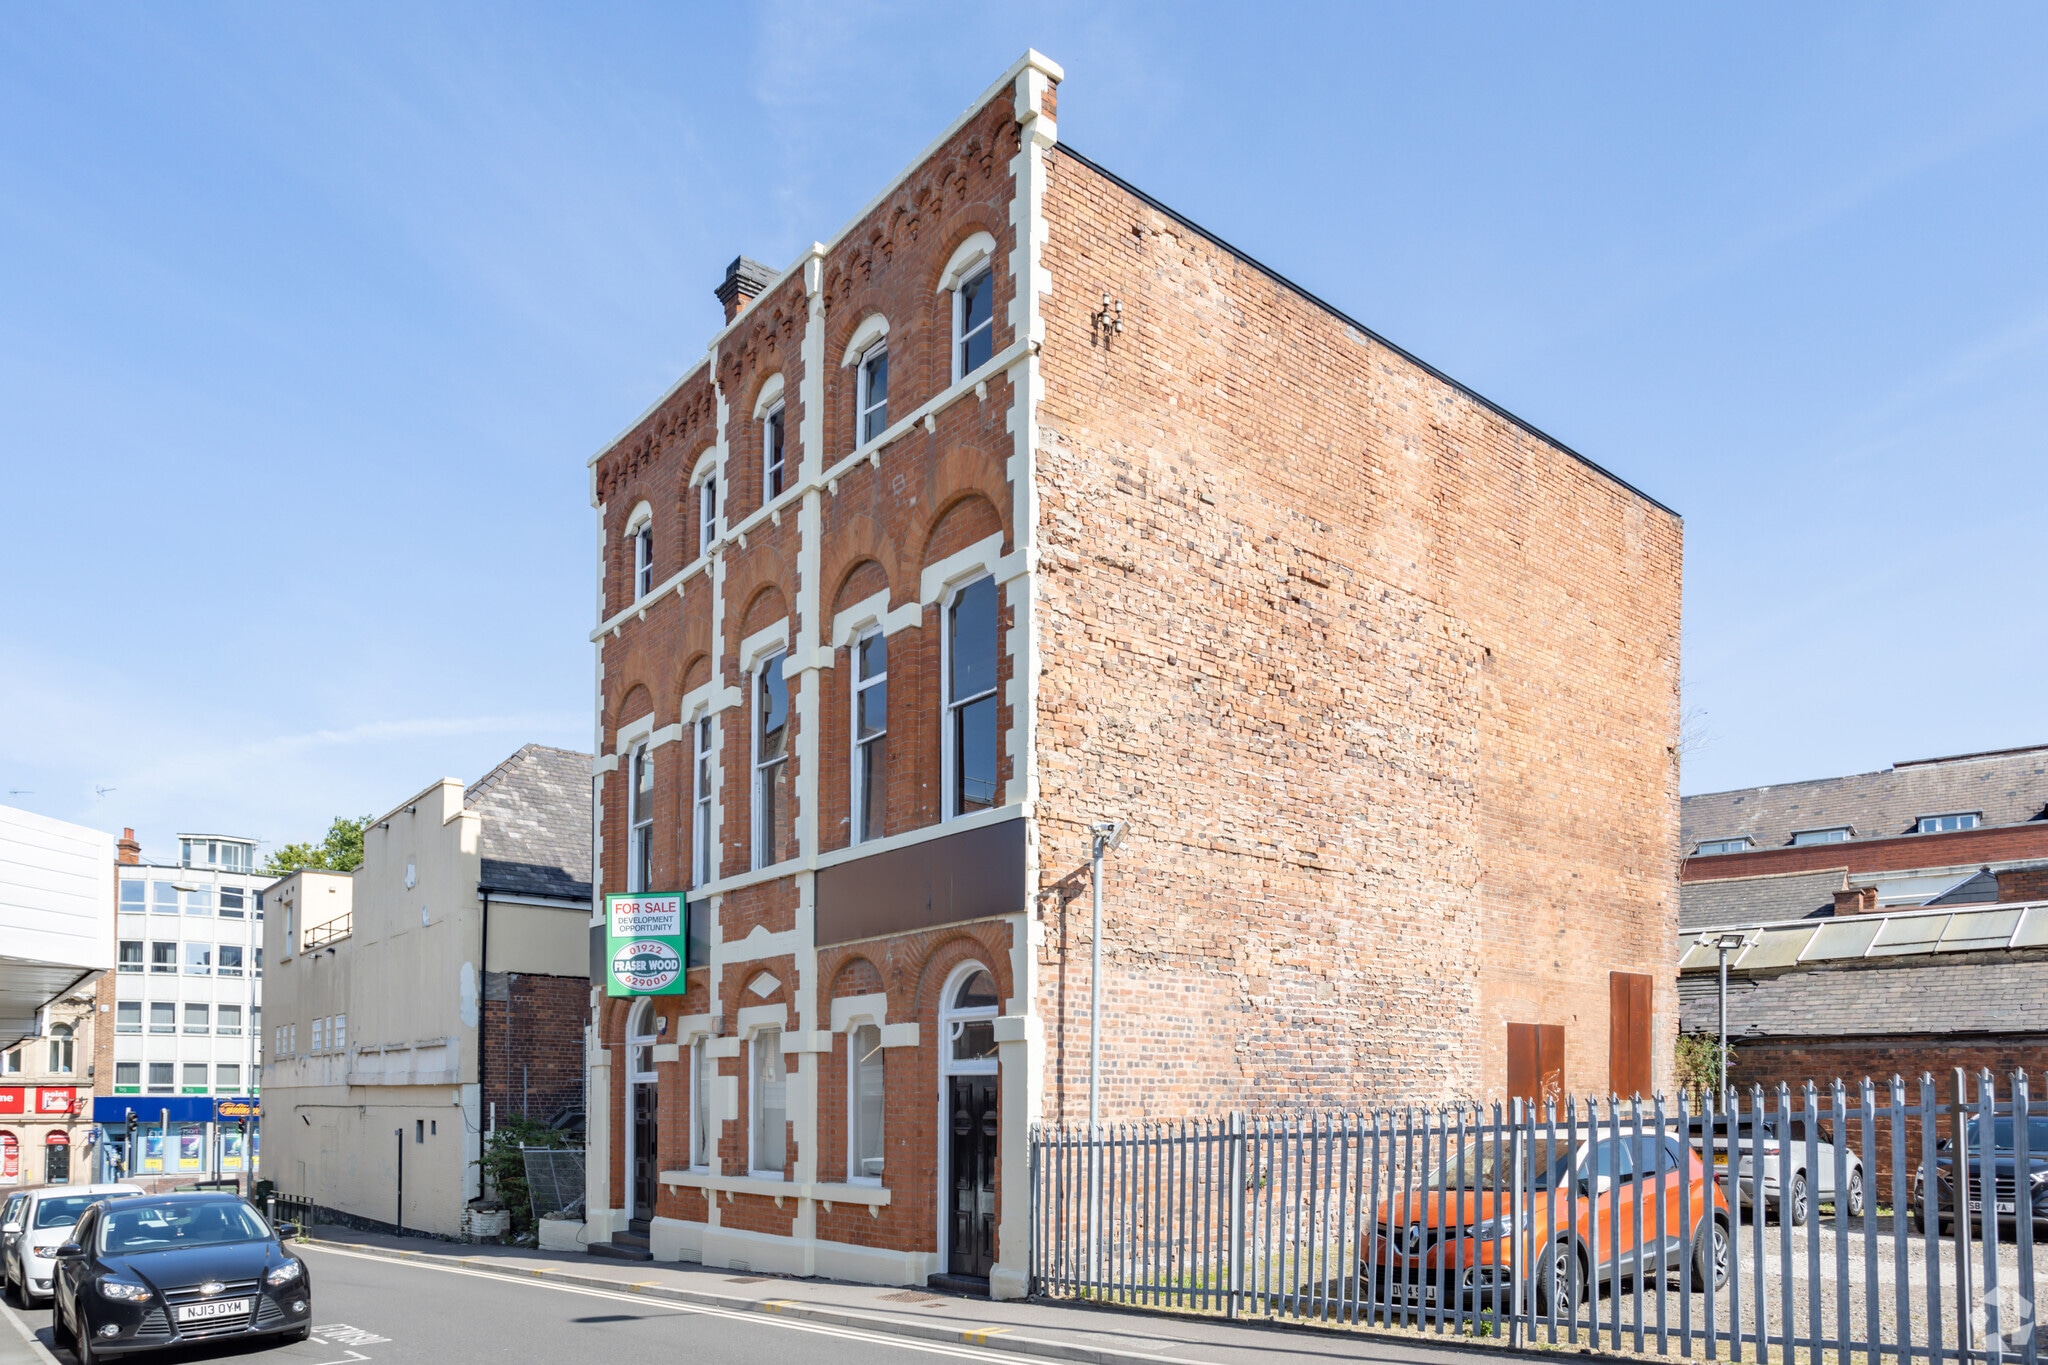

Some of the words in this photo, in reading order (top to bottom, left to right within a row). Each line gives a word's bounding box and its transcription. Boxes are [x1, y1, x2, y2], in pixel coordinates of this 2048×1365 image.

[615, 903, 640, 914] FOR
[645, 901, 677, 913] SALE
[618, 916, 674, 924] DEVELOPMENT
[619, 924, 673, 932] OPPORTUNITY
[629, 944, 663, 955] 01922
[614, 960, 647, 972] FRASER
[649, 959, 678, 971] WOOD
[625, 974, 668, 987] 629000
[188, 1305, 215, 1318] NJ13
